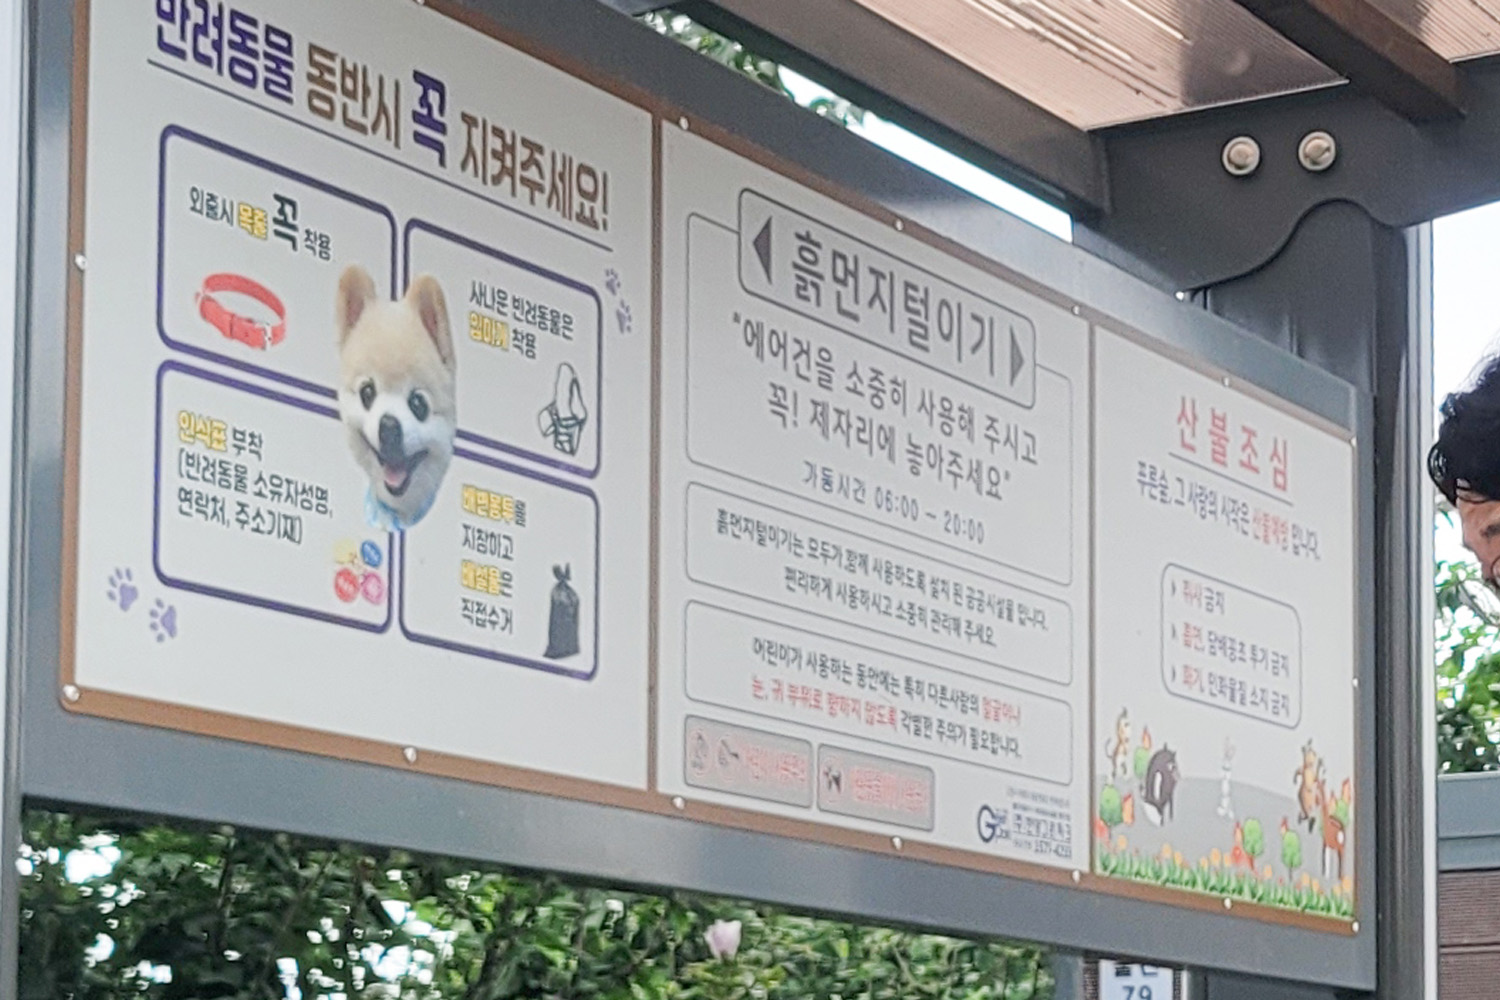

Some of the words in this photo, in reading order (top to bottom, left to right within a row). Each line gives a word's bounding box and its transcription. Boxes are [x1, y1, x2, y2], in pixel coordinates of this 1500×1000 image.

[306, 42, 401, 150] 동반시
[412, 69, 447, 169] 꼭
[460, 111, 608, 232] 지켜주세요!
[189, 186, 234, 226] 외출시
[272, 192, 298, 252] 꼭
[304, 228, 331, 261] 착용
[469, 280, 508, 317] 사나운
[512, 295, 574, 341] 반려동물은
[791, 230, 995, 377] 흙먼지털이기
[512, 327, 536, 360] 착용
[178, 410, 228, 452] 인식표
[232, 426, 263, 462] 부착
[768, 381, 799, 429] 꼭!
[809, 398, 896, 465] 제자리에
[845, 360, 907, 418] 소중히
[917, 387, 975, 445] 사용해
[983, 413, 1038, 466] 주시고
[1177, 395, 1288, 493] 산불조심
[178, 447, 248, 494] (반려동물
[253, 470, 333, 518] 소유자성명,
[178, 486, 230, 529] 연락처,
[235, 501, 303, 545] 주소기재)
[803, 459, 866, 505] 가동시간
[874, 485, 919, 522] 06:00
[943, 509, 985, 545] 20:00
[462, 523, 514, 561] 지참하고
[461, 597, 513, 635] 직접수거
